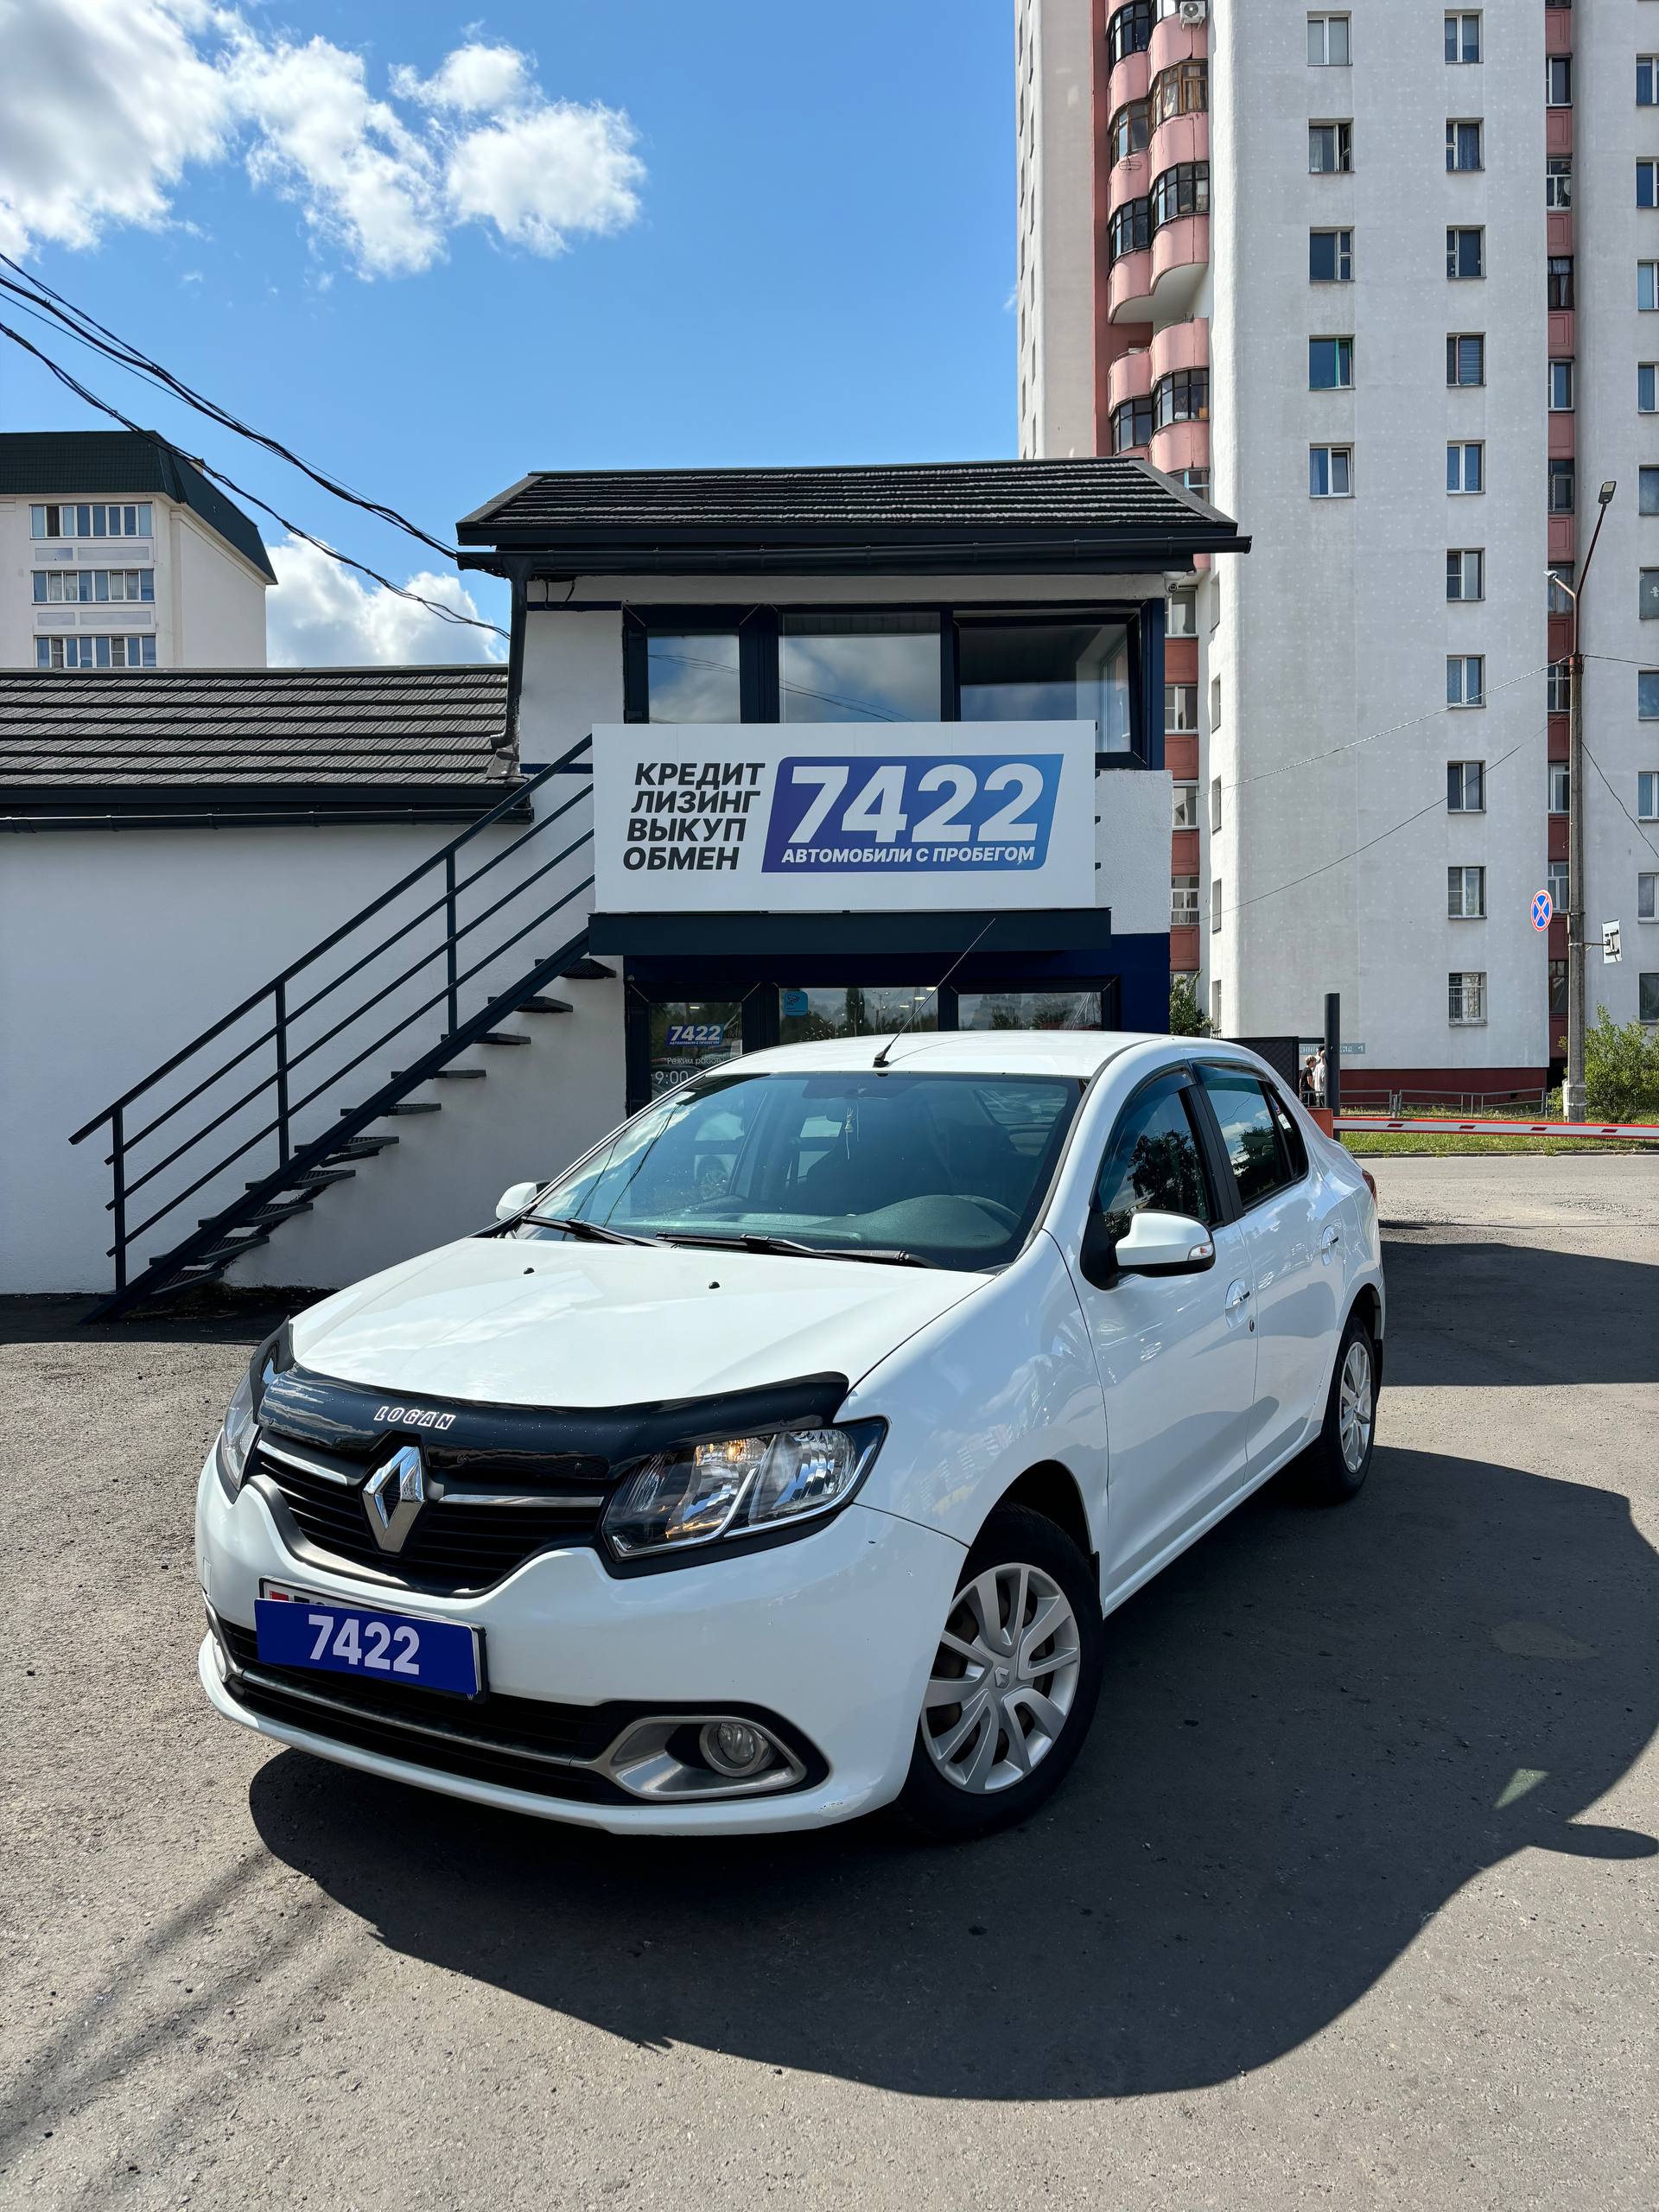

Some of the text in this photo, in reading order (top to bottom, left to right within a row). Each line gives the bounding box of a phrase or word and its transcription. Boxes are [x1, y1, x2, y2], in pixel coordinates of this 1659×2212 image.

[634, 762, 766, 791] КРЕДИТ
[631, 790, 761, 813] ЛИЗИНГ
[787, 763, 1045, 843] 7422
[626, 817, 747, 842] ВЫКУП
[622, 846, 740, 871] ОБМЕН
[781, 846, 1035, 863] АВТОМОБИЛИ С ПРОБЕГОМ
[671, 1026, 721, 1041] 7422
[655, 1071, 689, 1084] 9:00
[374, 1406, 456, 1430] LOGAN
[308, 1613, 420, 1675] 7422
